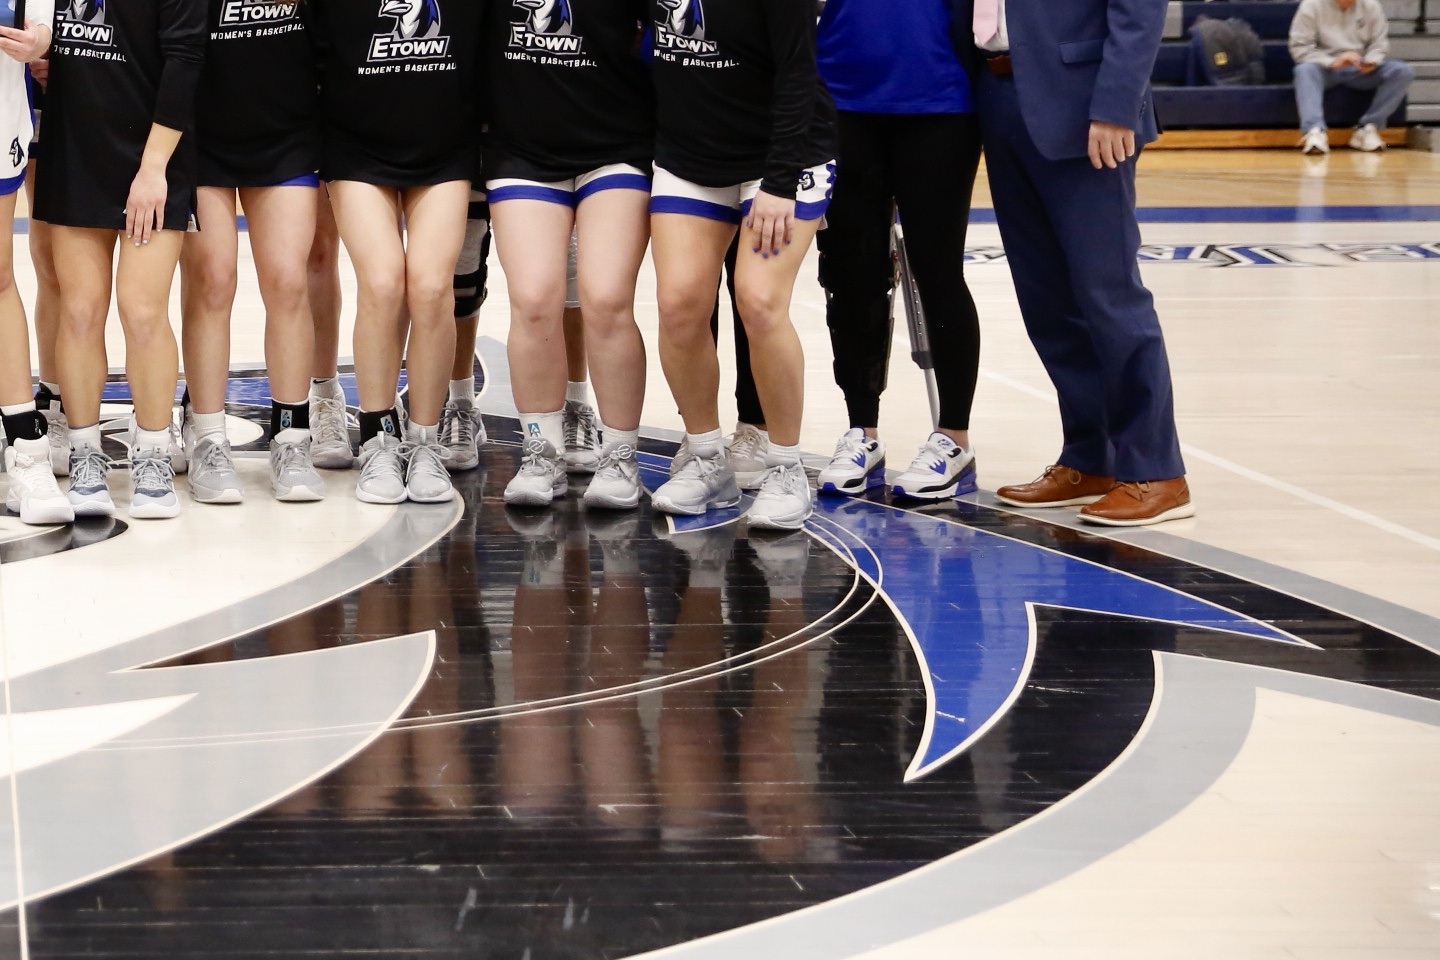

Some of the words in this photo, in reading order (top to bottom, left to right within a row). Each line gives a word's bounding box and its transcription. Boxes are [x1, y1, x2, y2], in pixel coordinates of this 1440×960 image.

[224, 1, 295, 22] ETOWN
[56, 15, 110, 42] TOWN
[210, 29, 252, 40] WOMEN'S
[255, 23, 305, 37] BASKETBAL
[513, 26, 578, 51] ETOWN
[371, 37, 445, 58] ETOWN
[657, 26, 716, 53] ETOWN
[357, 65, 401, 75] WOMEN'S
[404, 62, 457, 72] BASKETBAL
[682, 57, 740, 69] BASKETBAL
